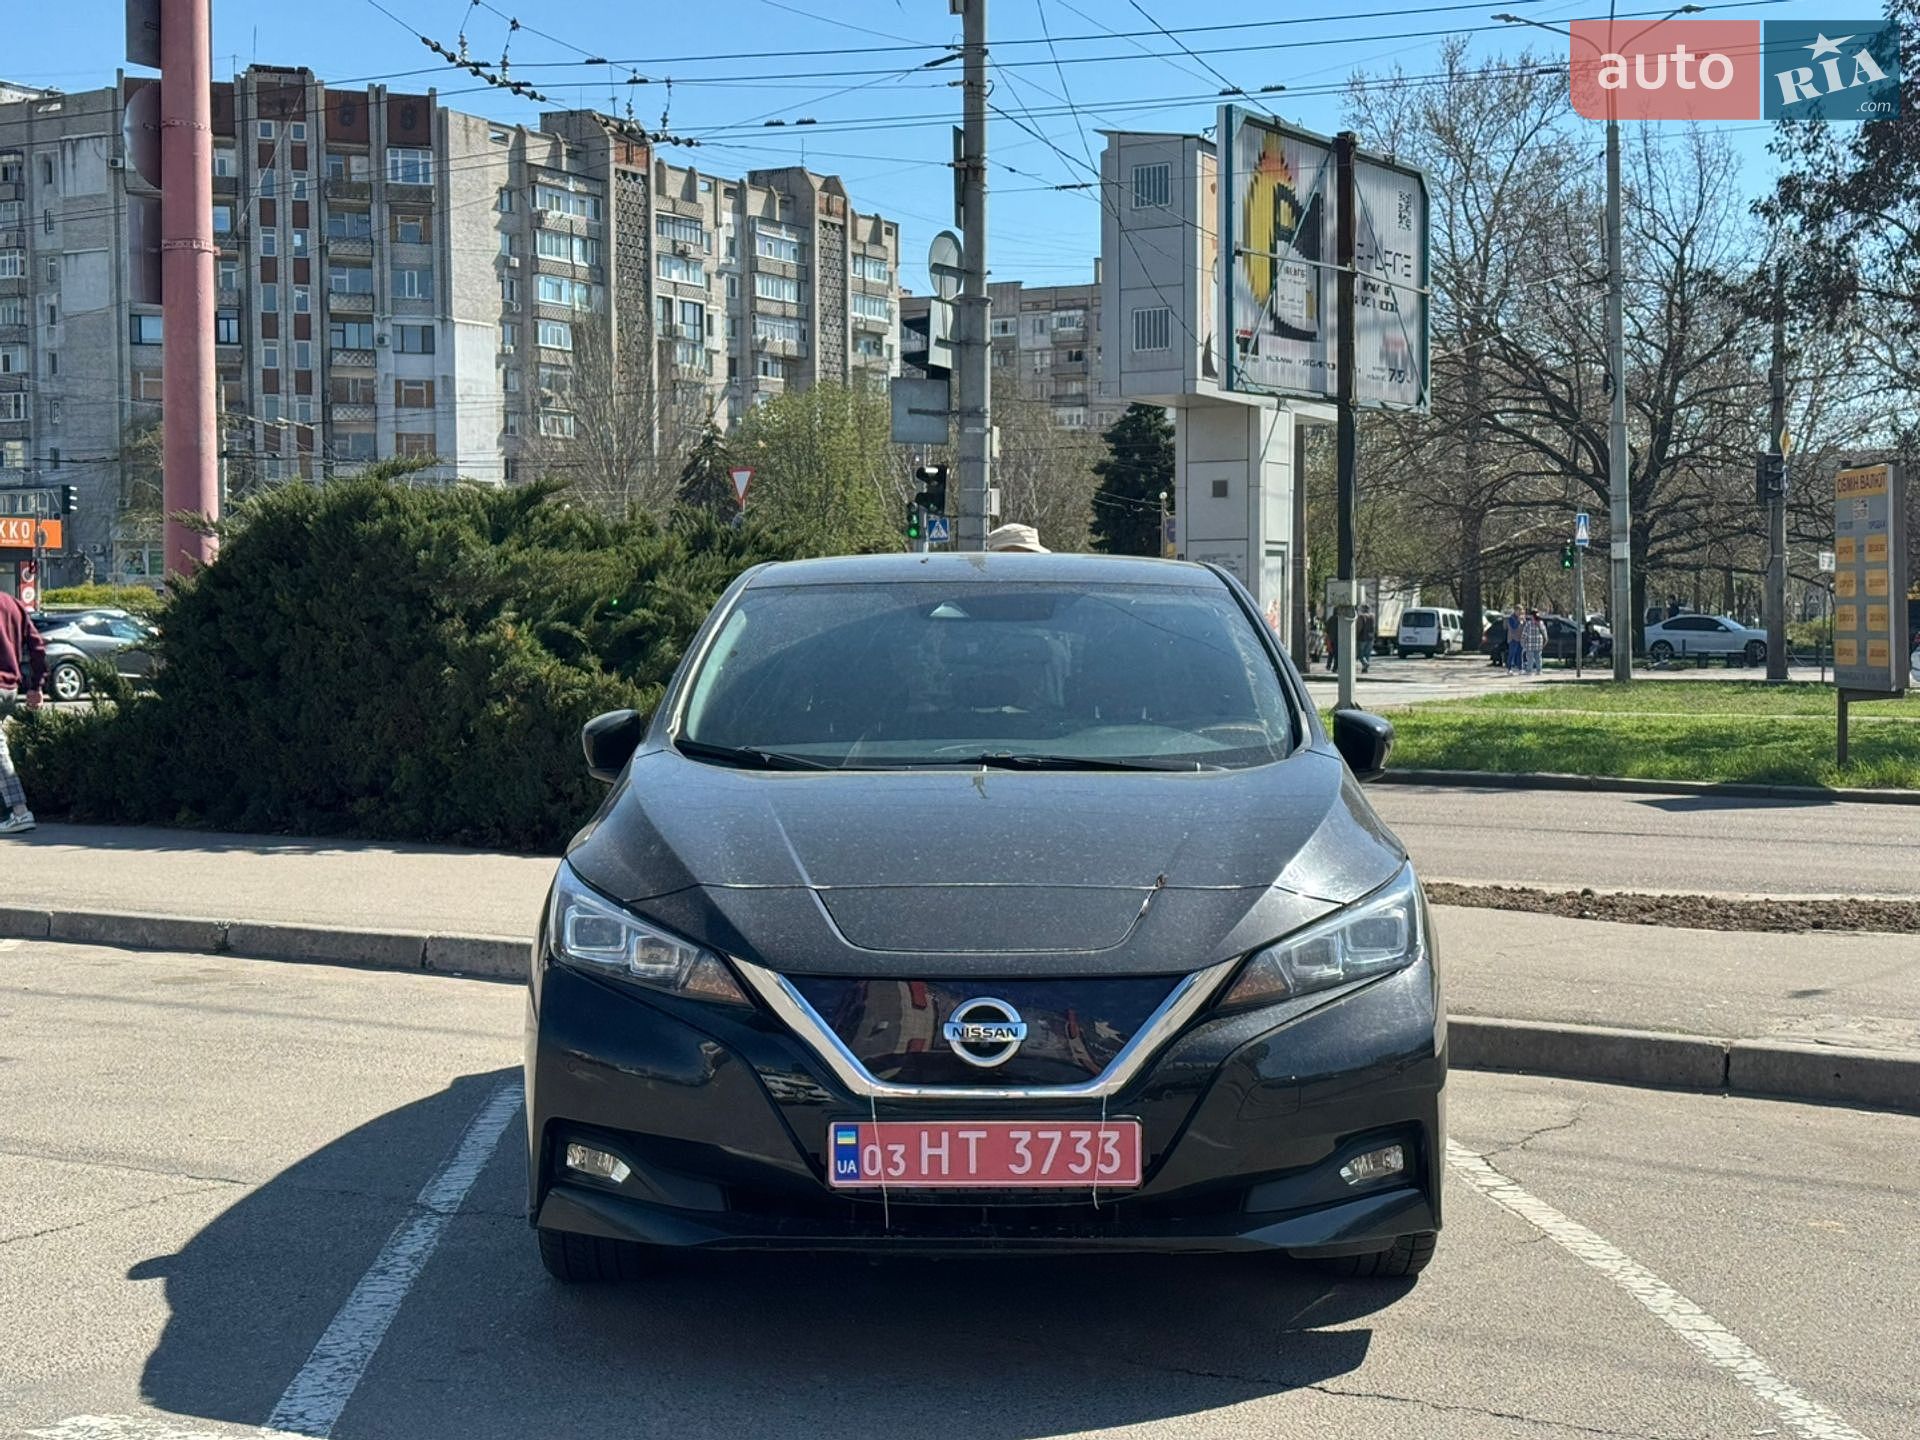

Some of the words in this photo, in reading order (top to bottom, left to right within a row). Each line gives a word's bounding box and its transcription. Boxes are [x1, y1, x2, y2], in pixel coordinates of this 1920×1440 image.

[952, 1026, 1019, 1039] NISSAN
[863, 1144, 906, 1177] 03
[920, 1130, 987, 1175] HT
[1008, 1130, 1122, 1175] 3733
[837, 1159, 857, 1174] UA
